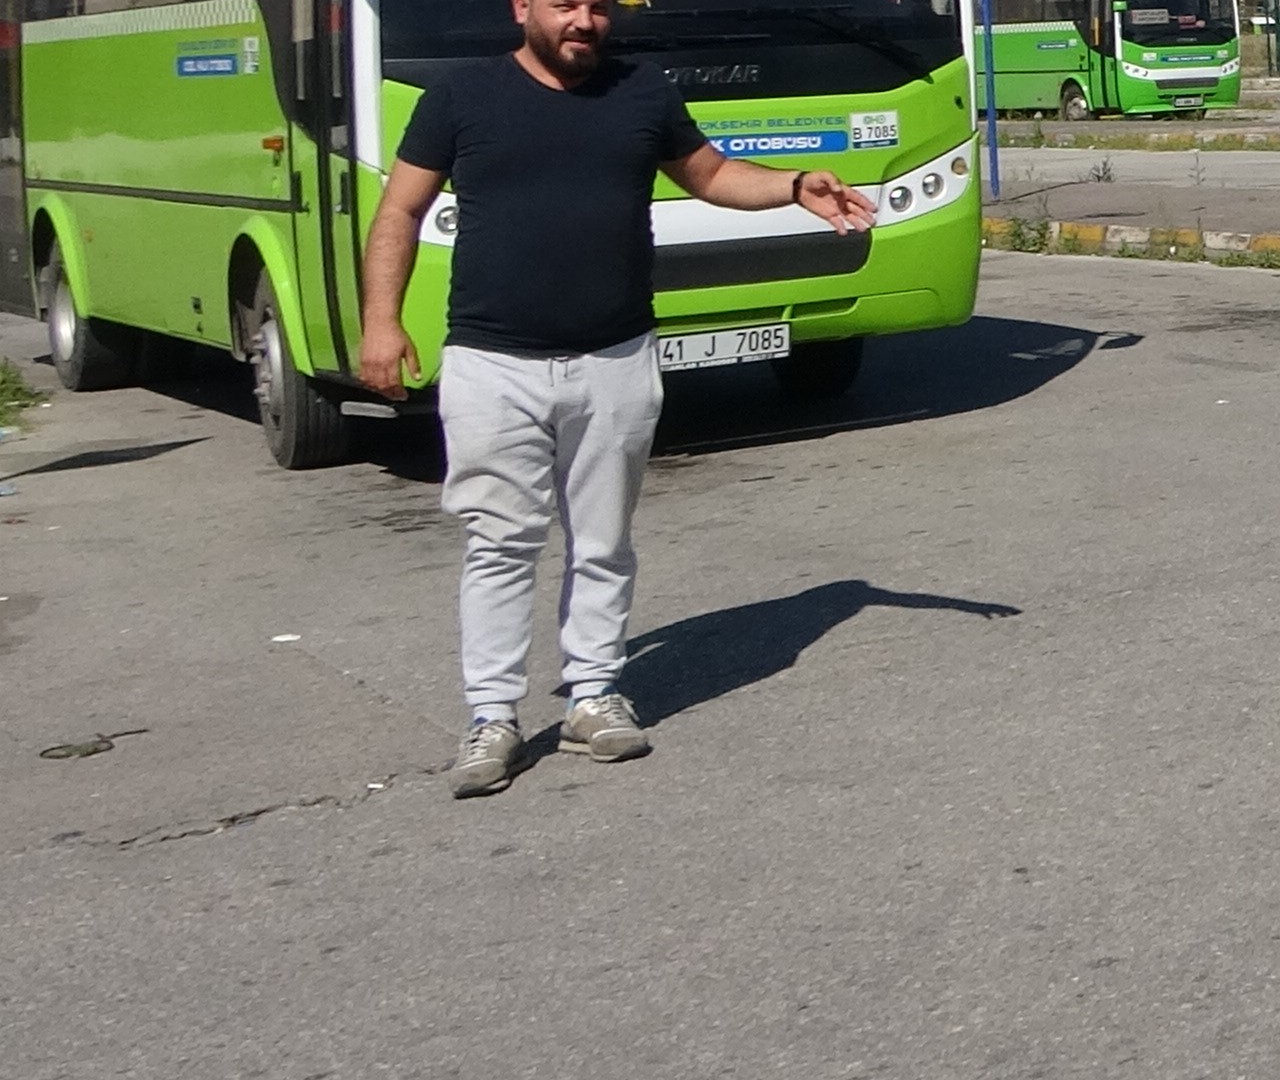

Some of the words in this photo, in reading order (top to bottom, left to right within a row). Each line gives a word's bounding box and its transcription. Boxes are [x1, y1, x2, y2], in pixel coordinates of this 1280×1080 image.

[853, 128, 862, 139] B
[867, 124, 897, 138] 7085
[729, 135, 822, 152] OTOBÜSÜ
[662, 340, 684, 361] 41
[704, 336, 716, 357] J
[736, 327, 784, 353] 7085
